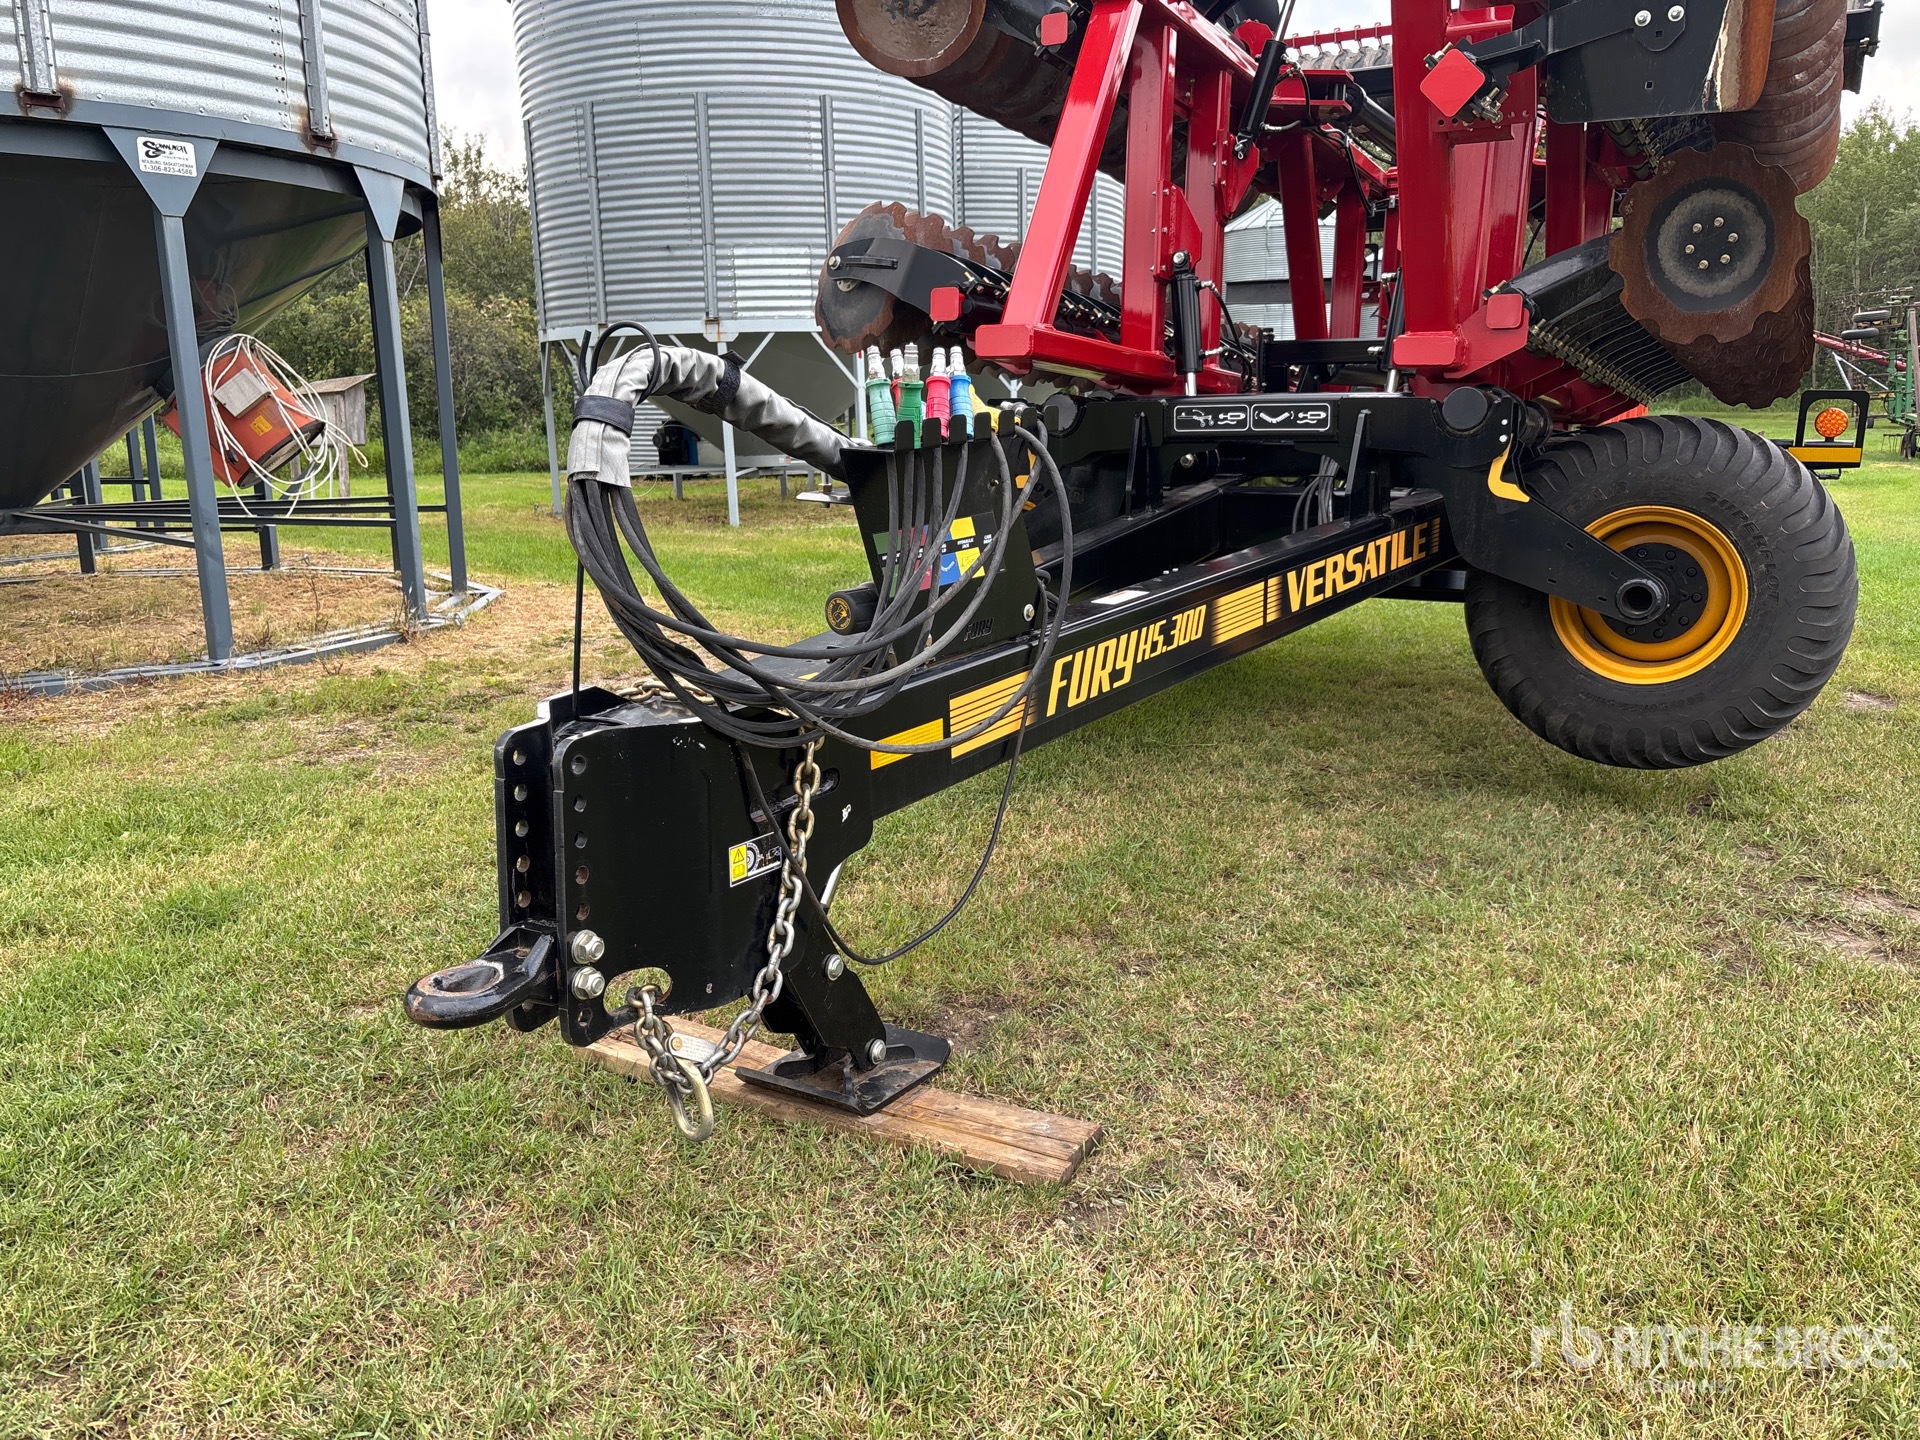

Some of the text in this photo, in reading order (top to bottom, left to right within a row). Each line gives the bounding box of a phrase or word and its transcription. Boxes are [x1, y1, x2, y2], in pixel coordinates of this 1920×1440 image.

[162, 160, 194, 169] SASKATCHEWAN
[1286, 523, 1428, 612] VERSATILE
[963, 617, 994, 642] FURY
[1046, 630, 1139, 718] FURY
